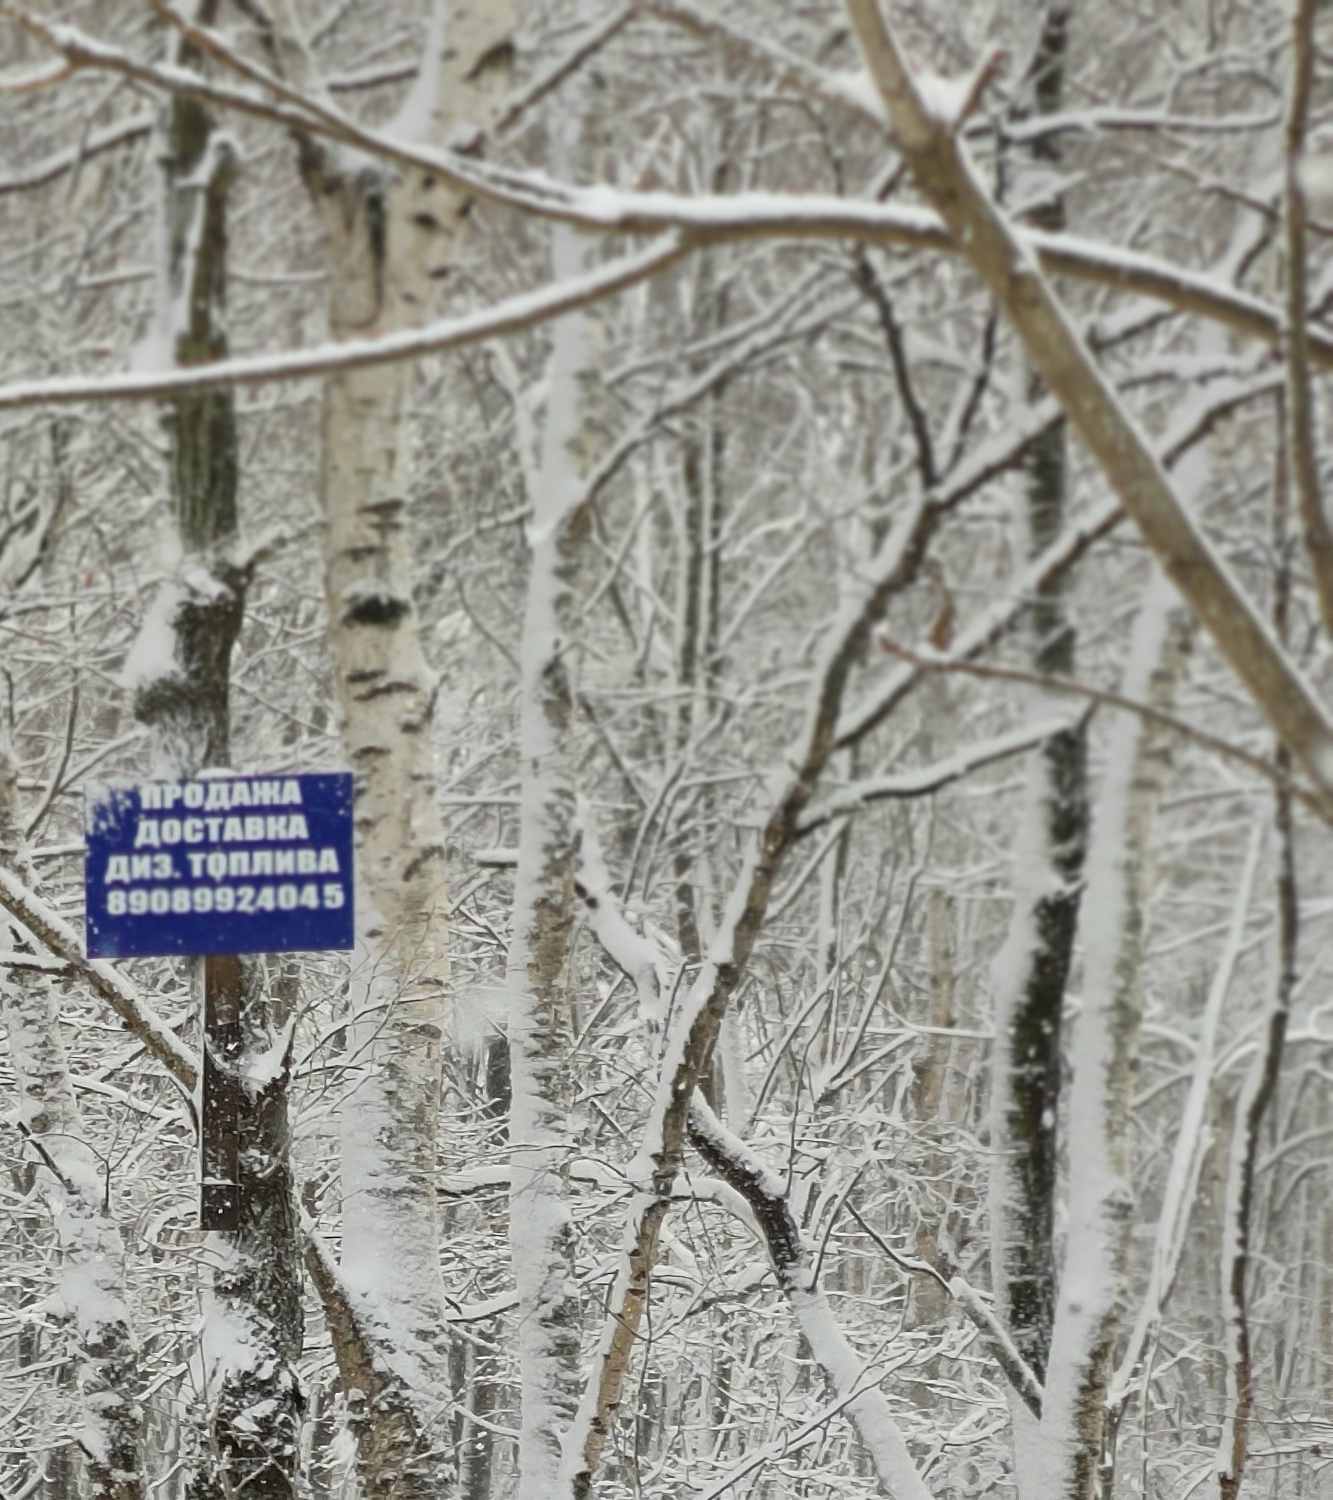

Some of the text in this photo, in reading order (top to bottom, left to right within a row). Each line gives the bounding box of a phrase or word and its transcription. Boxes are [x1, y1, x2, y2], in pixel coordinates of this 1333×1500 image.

[140, 780, 302, 811] ПРОДАЖА
[134, 815, 309, 848] ДОСТАВКА
[104, 848, 341, 884] ДИЗ. ТОПЛИВА
[106, 883, 345, 915] 89089924045
